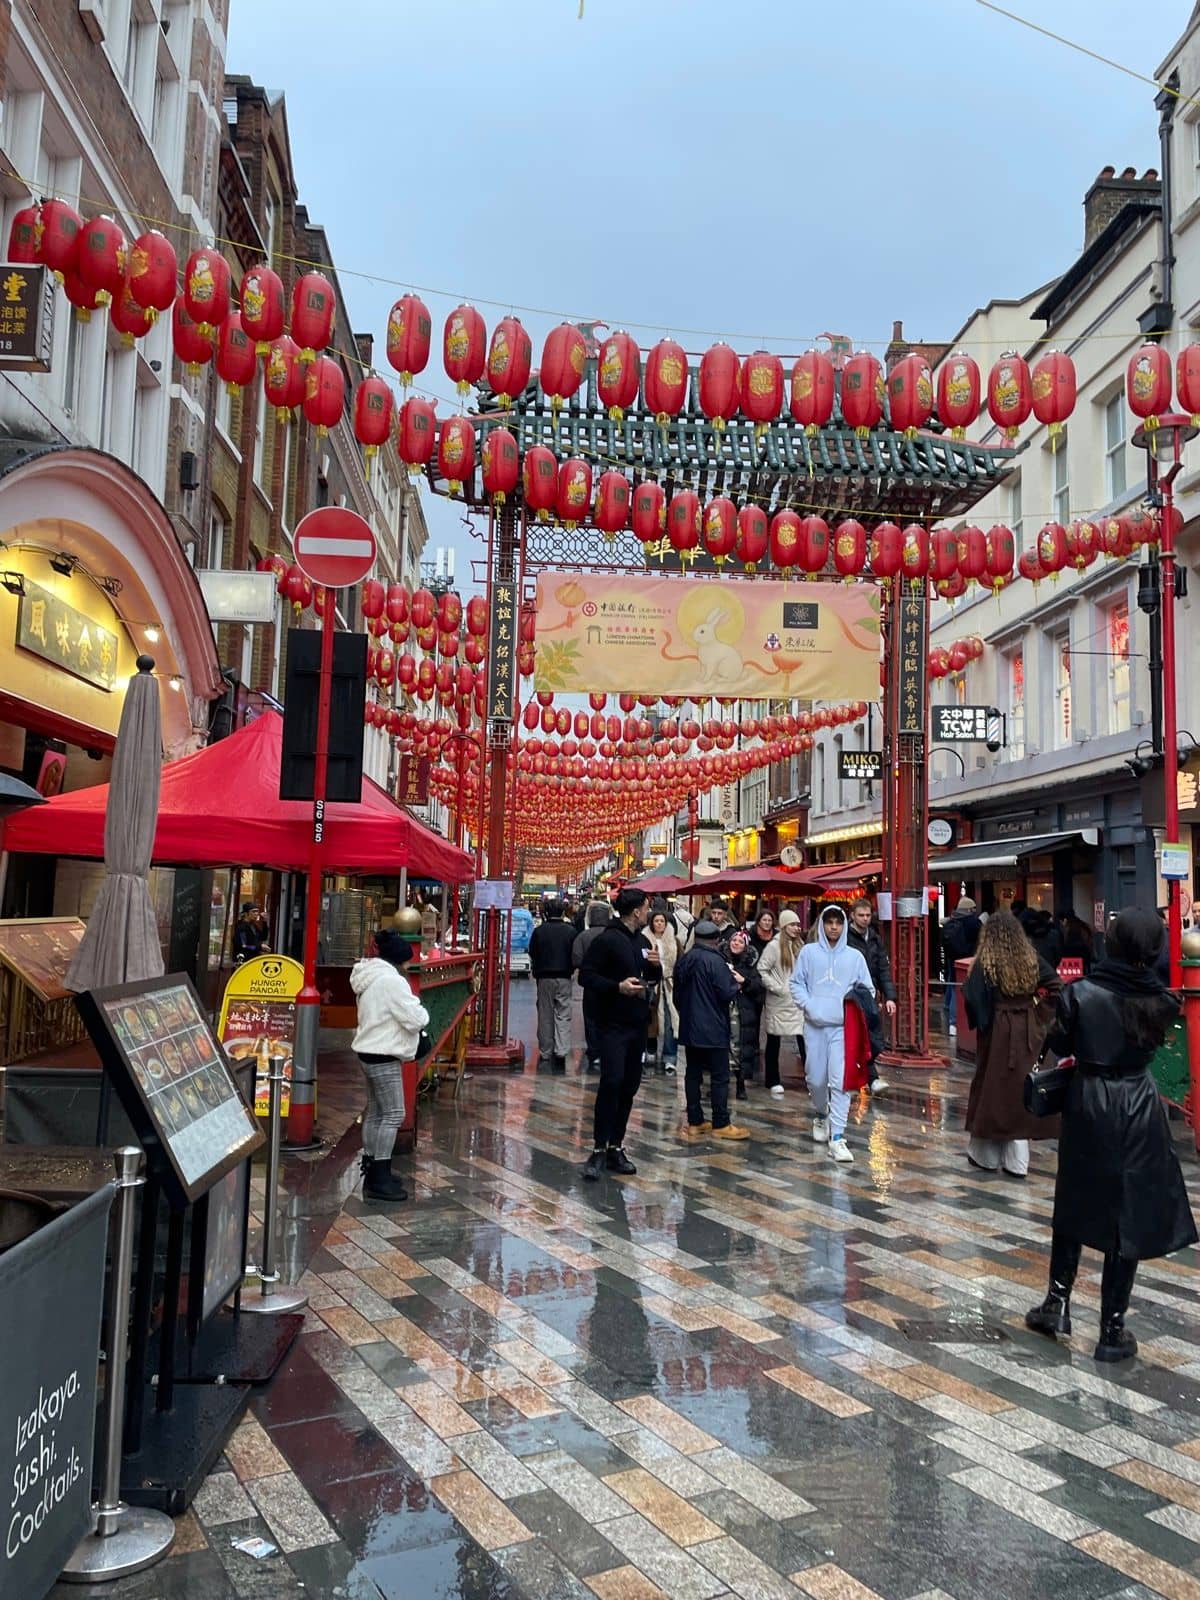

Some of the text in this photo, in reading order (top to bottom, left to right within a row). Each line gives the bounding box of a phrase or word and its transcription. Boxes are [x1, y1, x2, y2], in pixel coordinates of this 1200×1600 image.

[941, 720, 974, 731] TCW
[941, 731, 975, 739] Hair Salon
[843, 754, 880, 765] MIKO
[250, 979, 288, 987] HUNGRY
[15, 1369, 81, 1456] Izakaya.
[11, 1430, 57, 1508] Sushi.
[6, 1447, 84, 1559] Cocktails.
